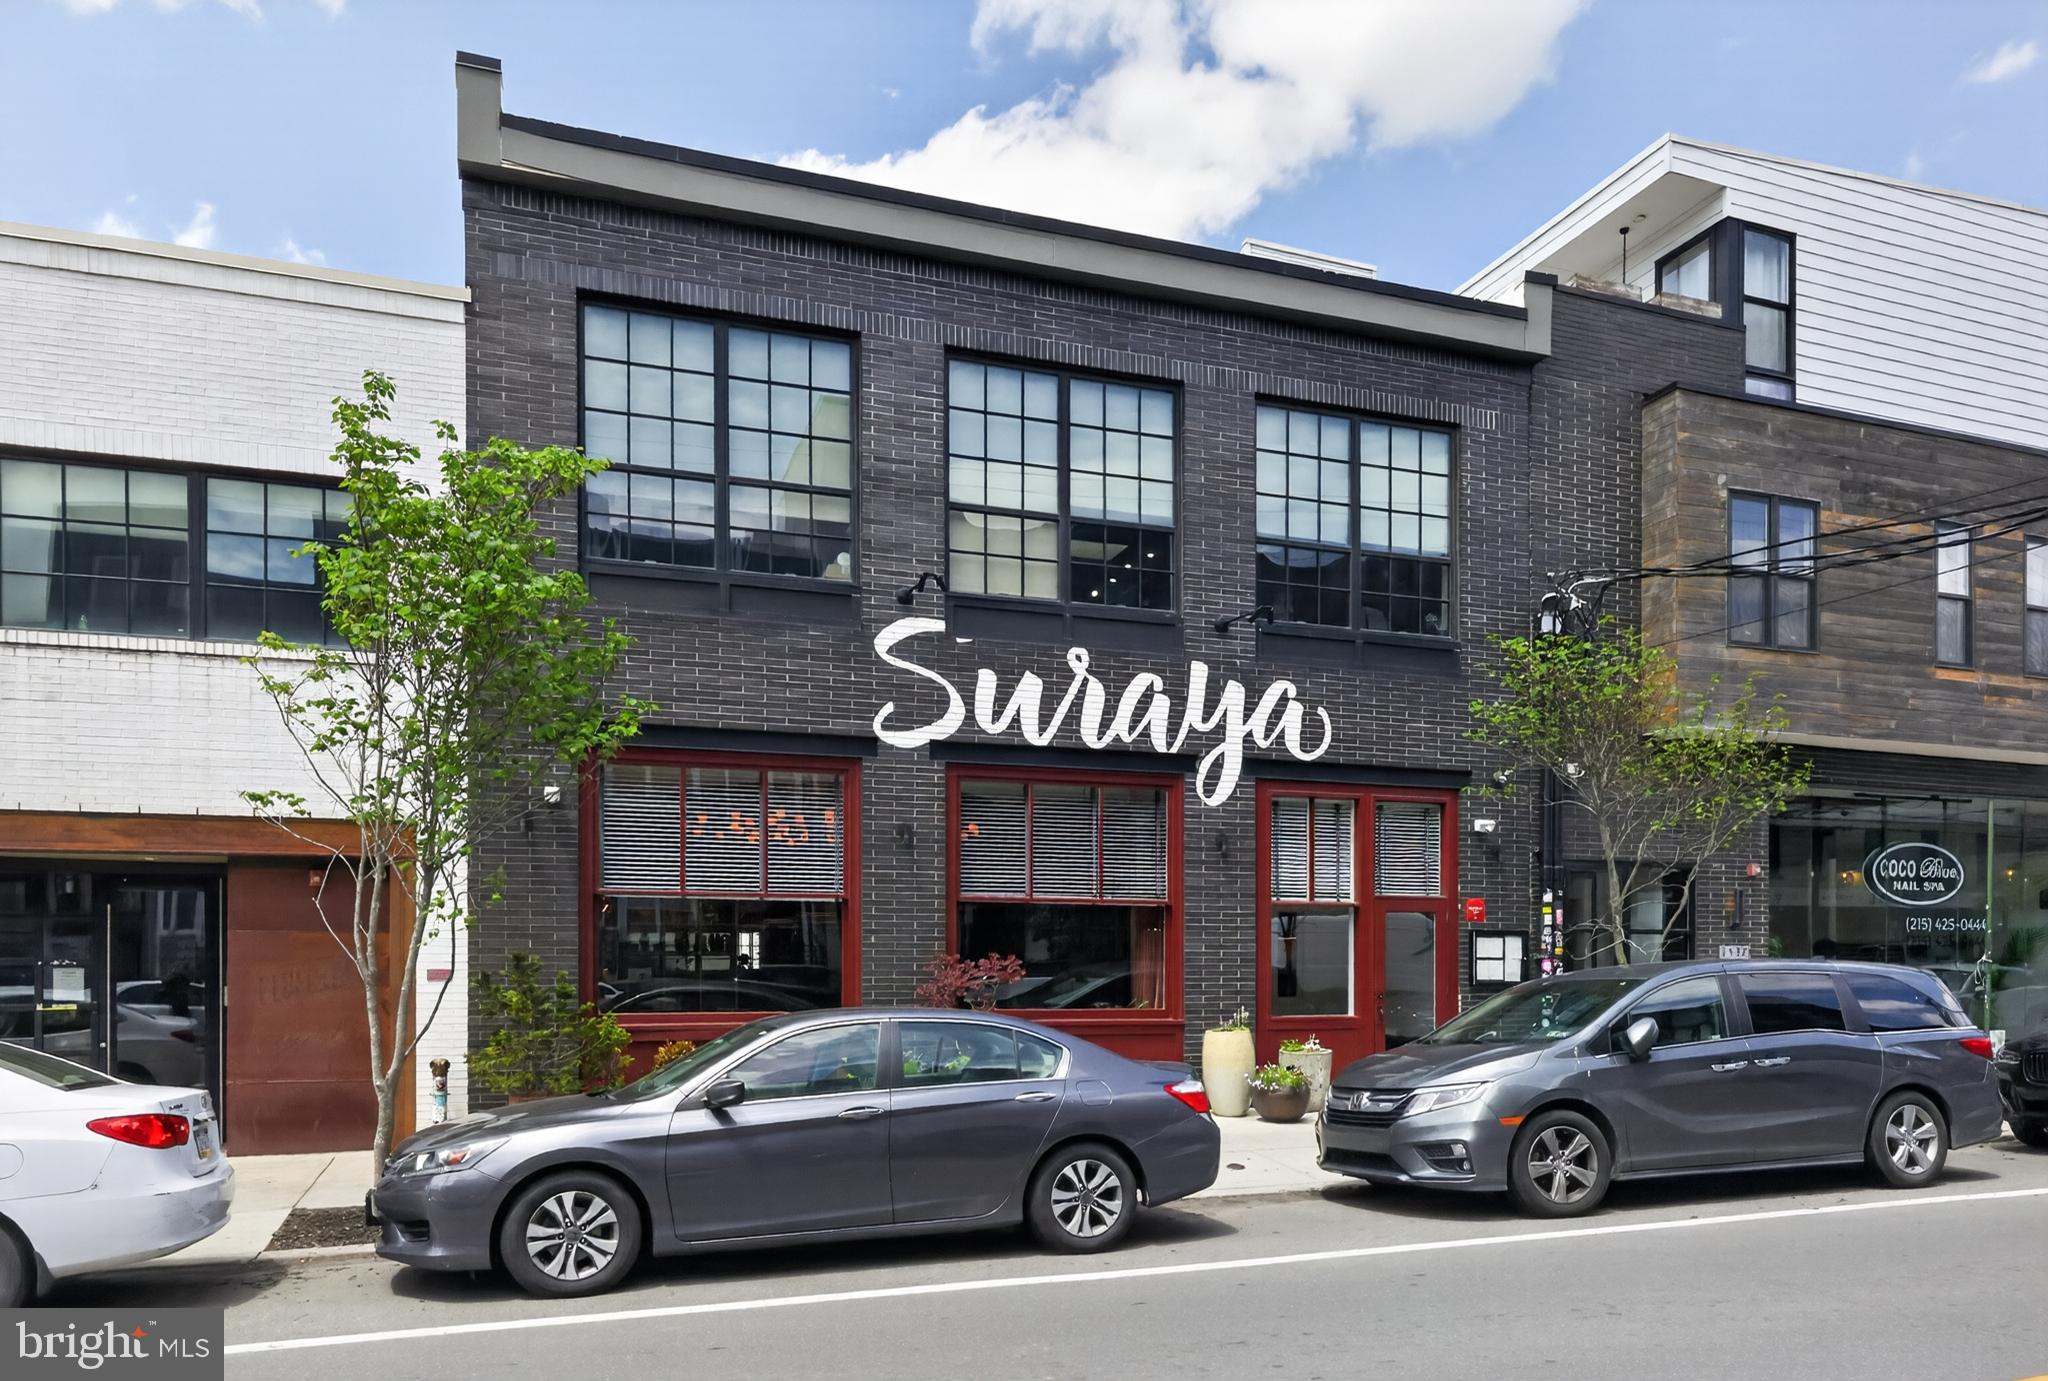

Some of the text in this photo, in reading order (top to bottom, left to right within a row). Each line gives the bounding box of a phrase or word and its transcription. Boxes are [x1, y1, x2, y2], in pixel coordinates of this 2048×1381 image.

[873, 617, 1331, 806] Suraya
[1880, 857, 1960, 881] COCO Blue
[1893, 880, 1945, 892] NAIL SPA
[1905, 916, 1932, 932] (215)
